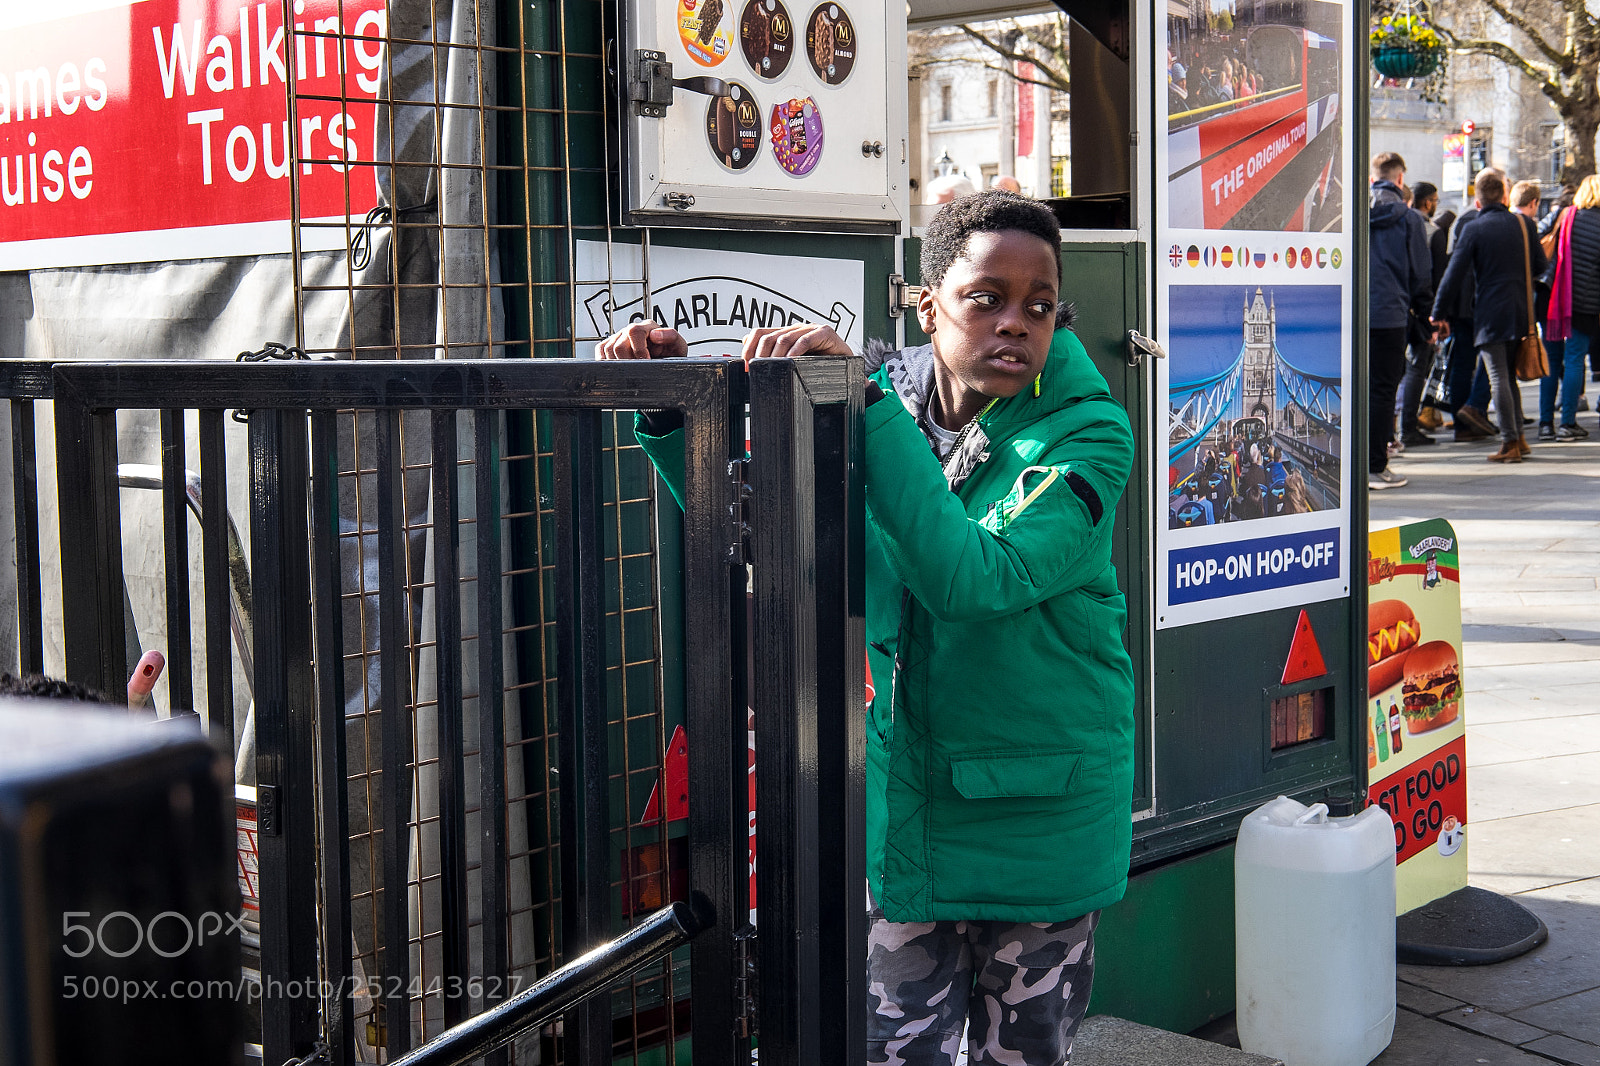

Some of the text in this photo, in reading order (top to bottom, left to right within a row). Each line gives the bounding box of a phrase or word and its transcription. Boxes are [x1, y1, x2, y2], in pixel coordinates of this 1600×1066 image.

[153, 0, 386, 99] Walking
[773, 43, 786, 52] MINT
[834, 49, 853, 59] ALMOND
[187, 107, 358, 186] Tours
[739, 130, 757, 138] DOUBLE
[1, 131, 94, 207] uise
[1211, 121, 1306, 206] THE ORIGINAL TOUR
[1176, 553, 1251, 588] HOP-ON
[1256, 541, 1334, 577] HOP-OFF
[1406, 753, 1460, 808] FOOD
[1412, 800, 1443, 840] GO
